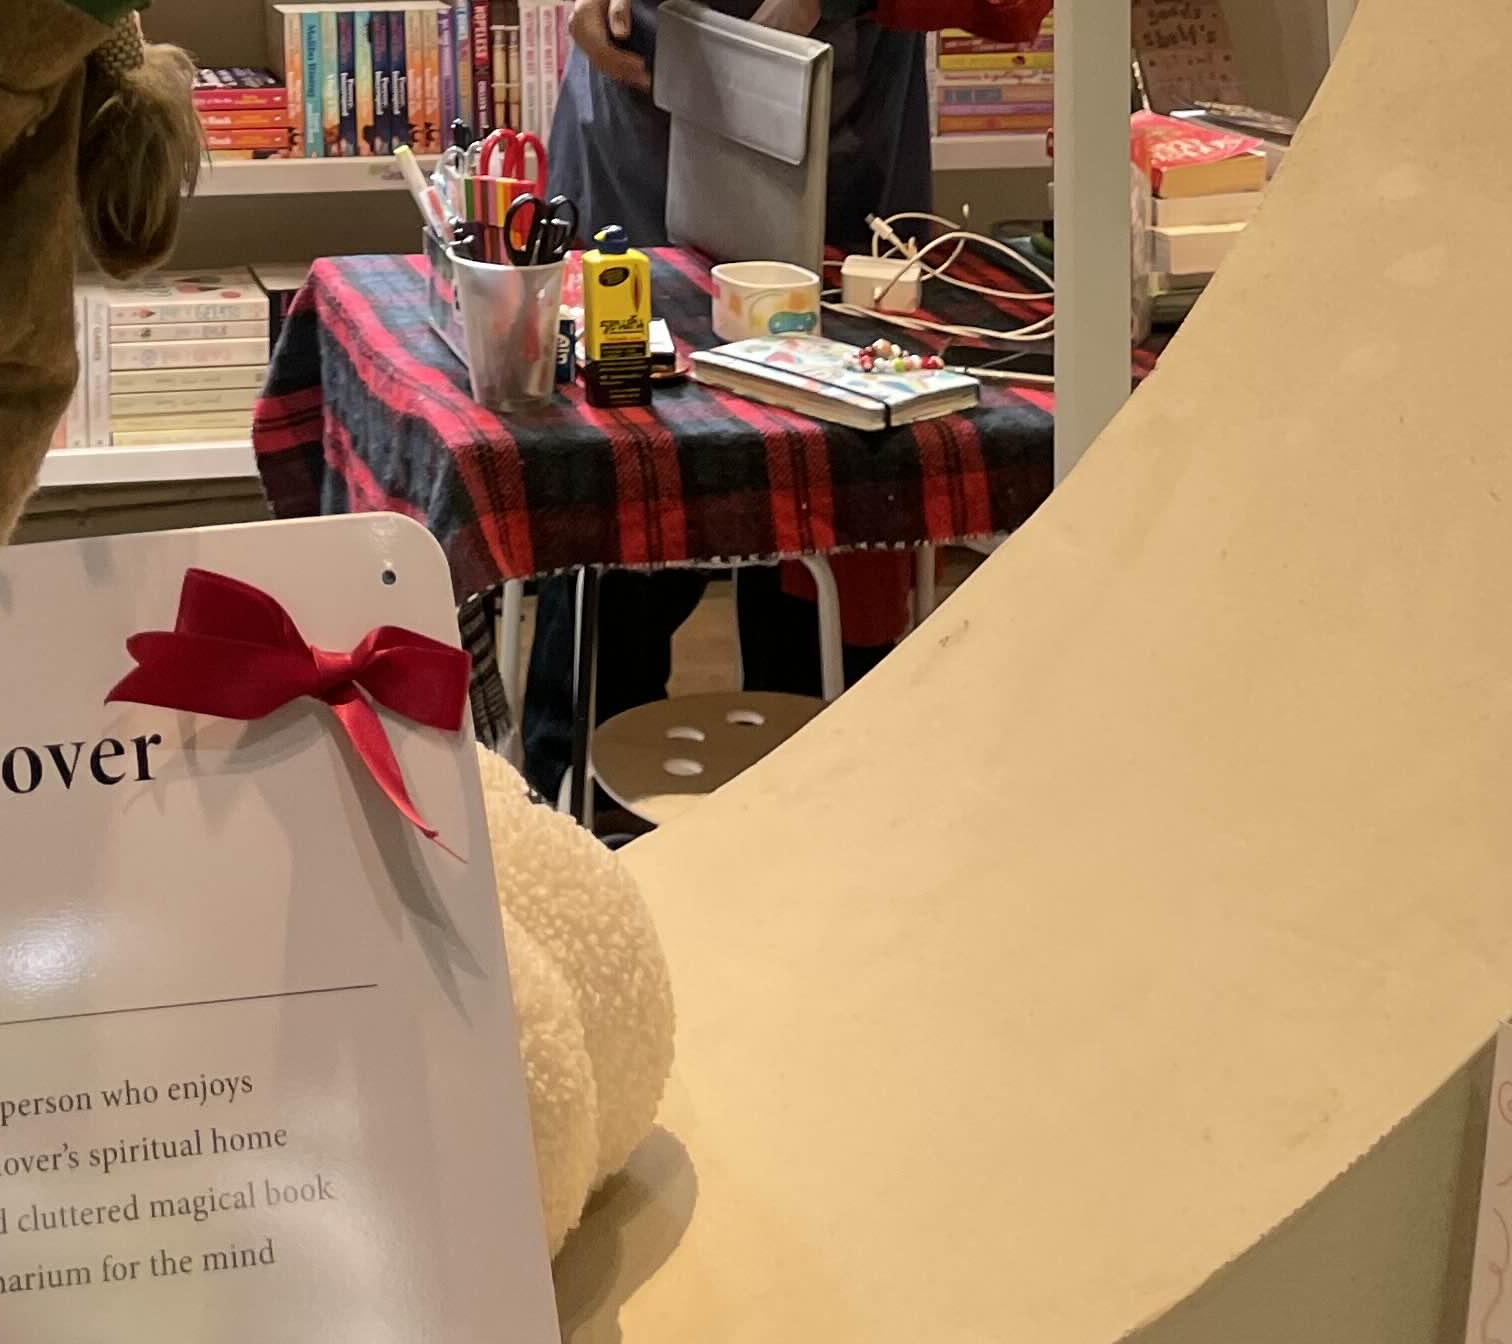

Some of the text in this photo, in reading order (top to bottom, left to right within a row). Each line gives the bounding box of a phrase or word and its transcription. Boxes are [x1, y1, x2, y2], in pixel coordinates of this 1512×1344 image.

[474, 5, 489, 60] HOPELESS
[0, 1087, 94, 1132] person
[101, 1077, 160, 1111] who
[167, 1069, 254, 1114] enjoys
[88, 1127, 204, 1175] spiritual
[210, 1122, 288, 1154] home
[16, 1194, 140, 1236] cluttered
[148, 1184, 257, 1233] magical
[264, 1174, 335, 1208] book
[101, 1253, 142, 1285] for
[148, 1250, 193, 1279] the
[202, 1239, 276, 1272] mind
